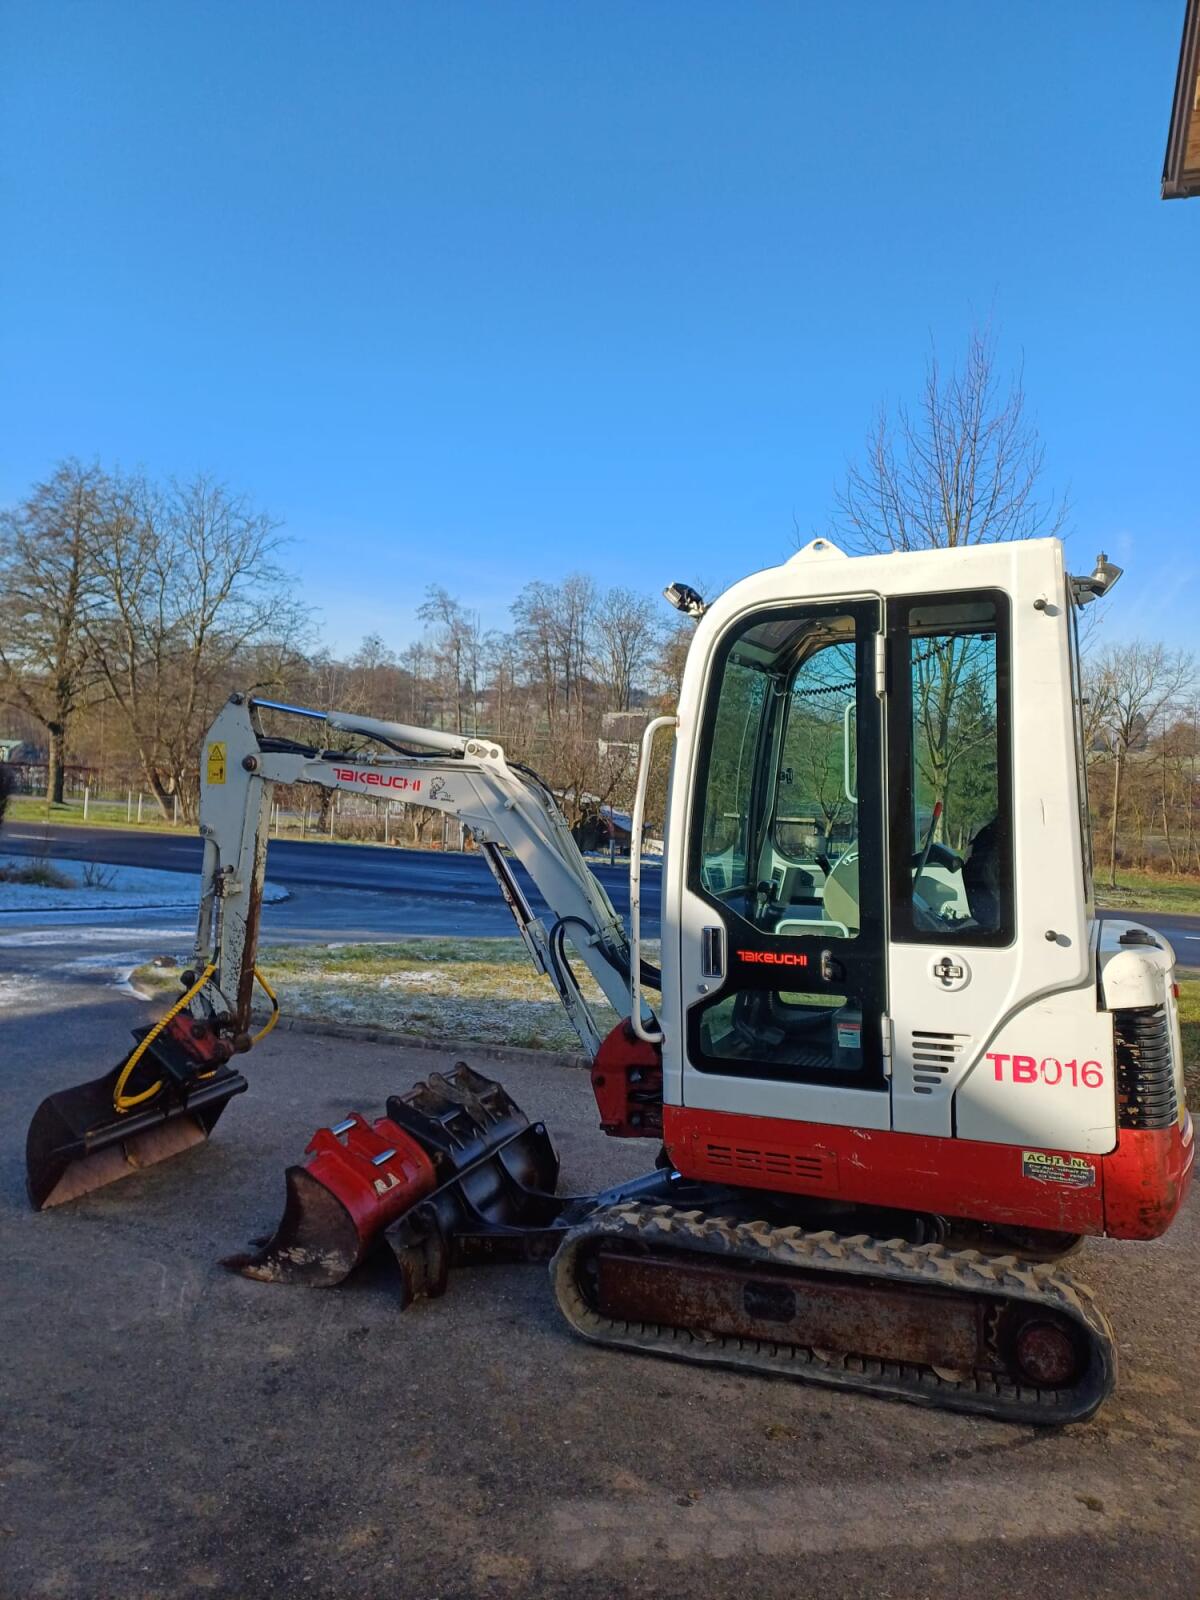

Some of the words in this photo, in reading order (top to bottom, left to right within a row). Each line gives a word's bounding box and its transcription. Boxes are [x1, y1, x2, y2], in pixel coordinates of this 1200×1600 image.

[332, 768, 421, 792] TAKEUCHI
[736, 949, 808, 967] TAKEUCHI
[986, 1052, 1104, 1089] TB016
